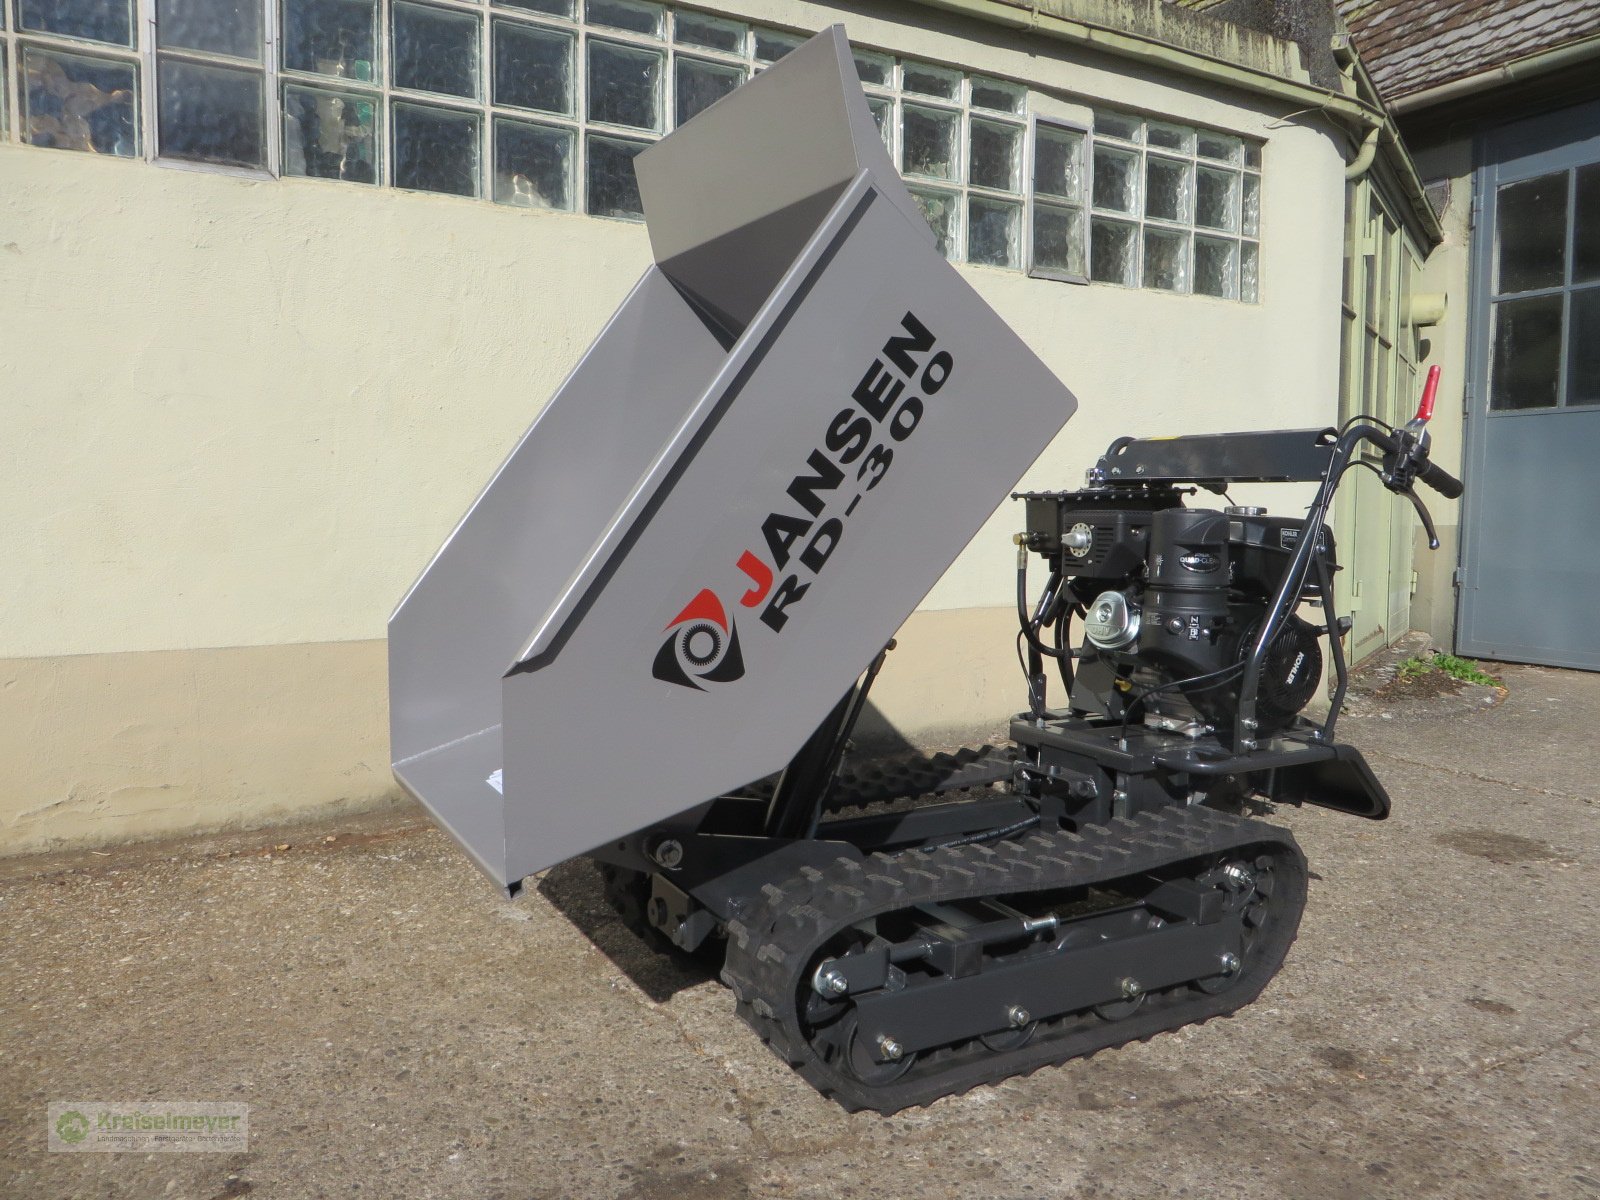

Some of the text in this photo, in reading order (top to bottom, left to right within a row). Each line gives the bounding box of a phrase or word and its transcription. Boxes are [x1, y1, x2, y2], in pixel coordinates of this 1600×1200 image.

[736, 311, 936, 608] JANSEN
[760, 350, 953, 634] RD-300
[1285, 651, 1305, 685] KOHLER
